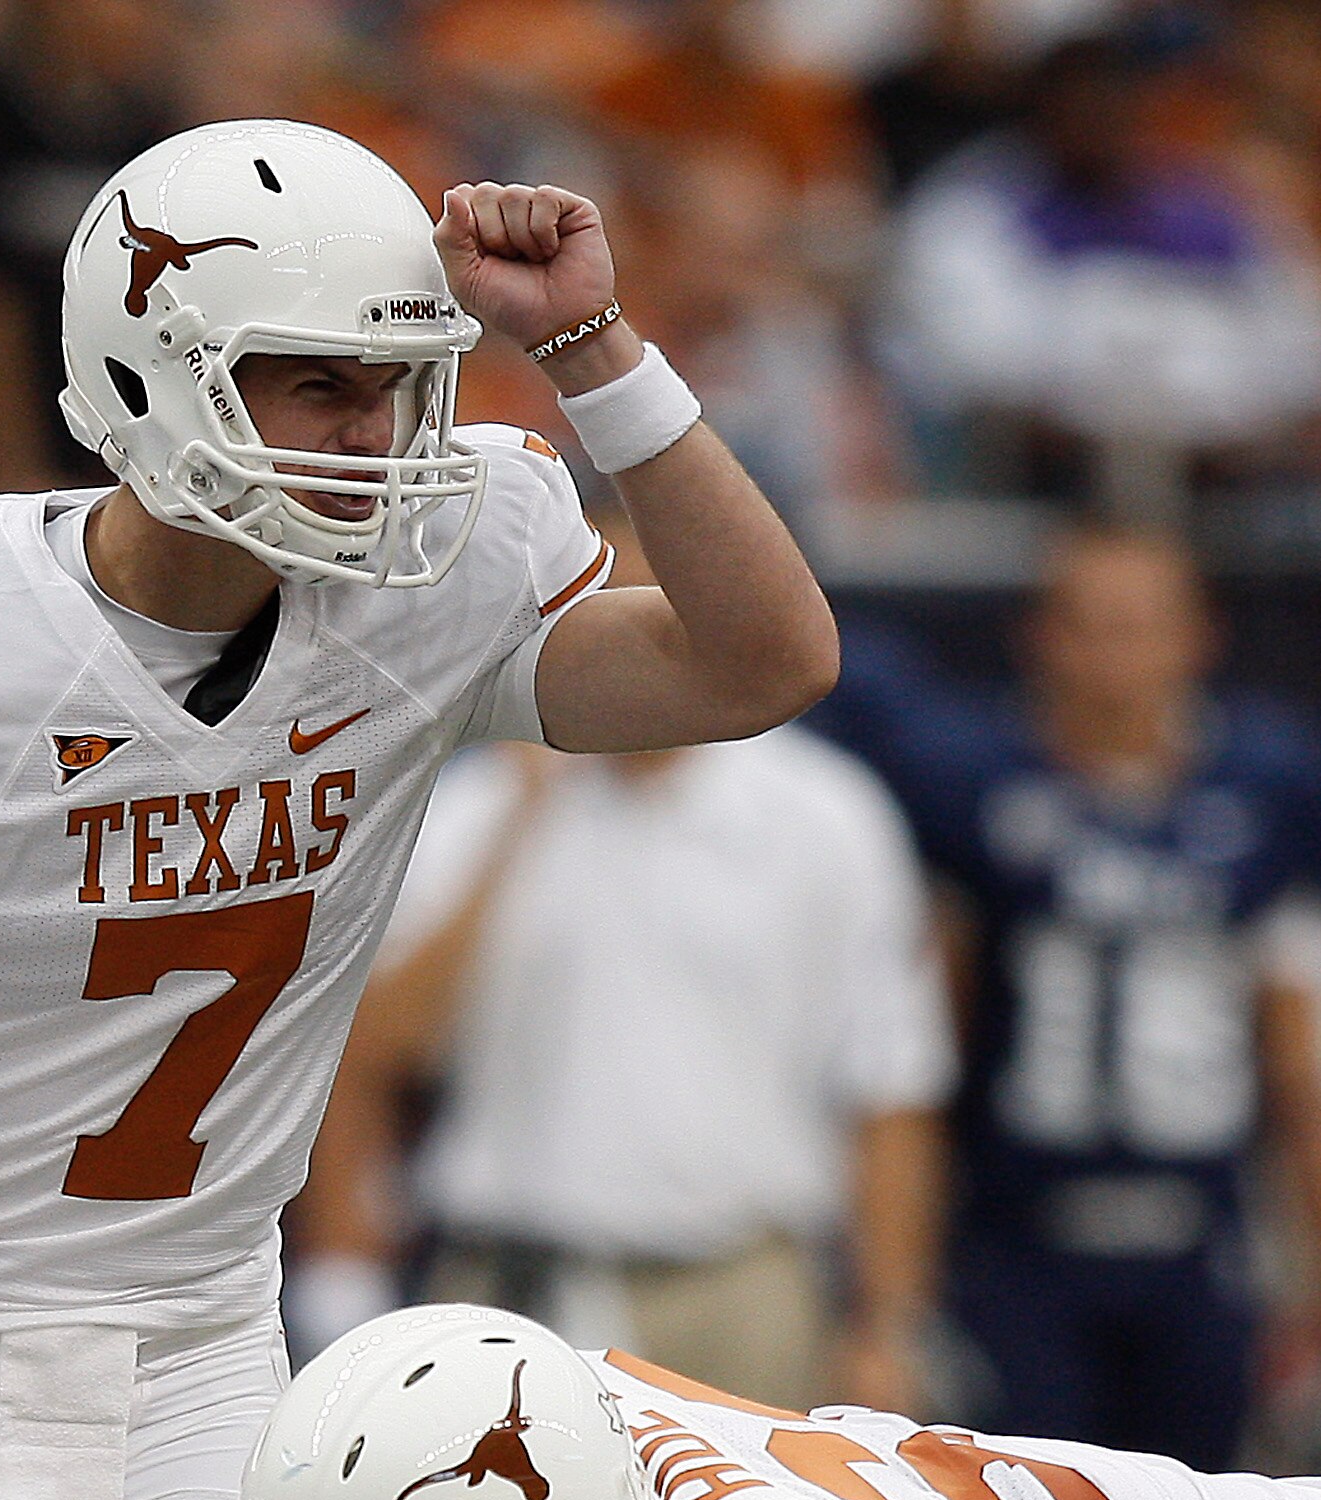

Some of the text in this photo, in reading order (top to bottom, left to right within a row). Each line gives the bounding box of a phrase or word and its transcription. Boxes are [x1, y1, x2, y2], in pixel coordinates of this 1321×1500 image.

[389, 299, 437, 320] HORNS
[184, 346, 236, 422] Ridell
[66, 769, 357, 904] TEXAS
[60, 890, 316, 1202] 7
